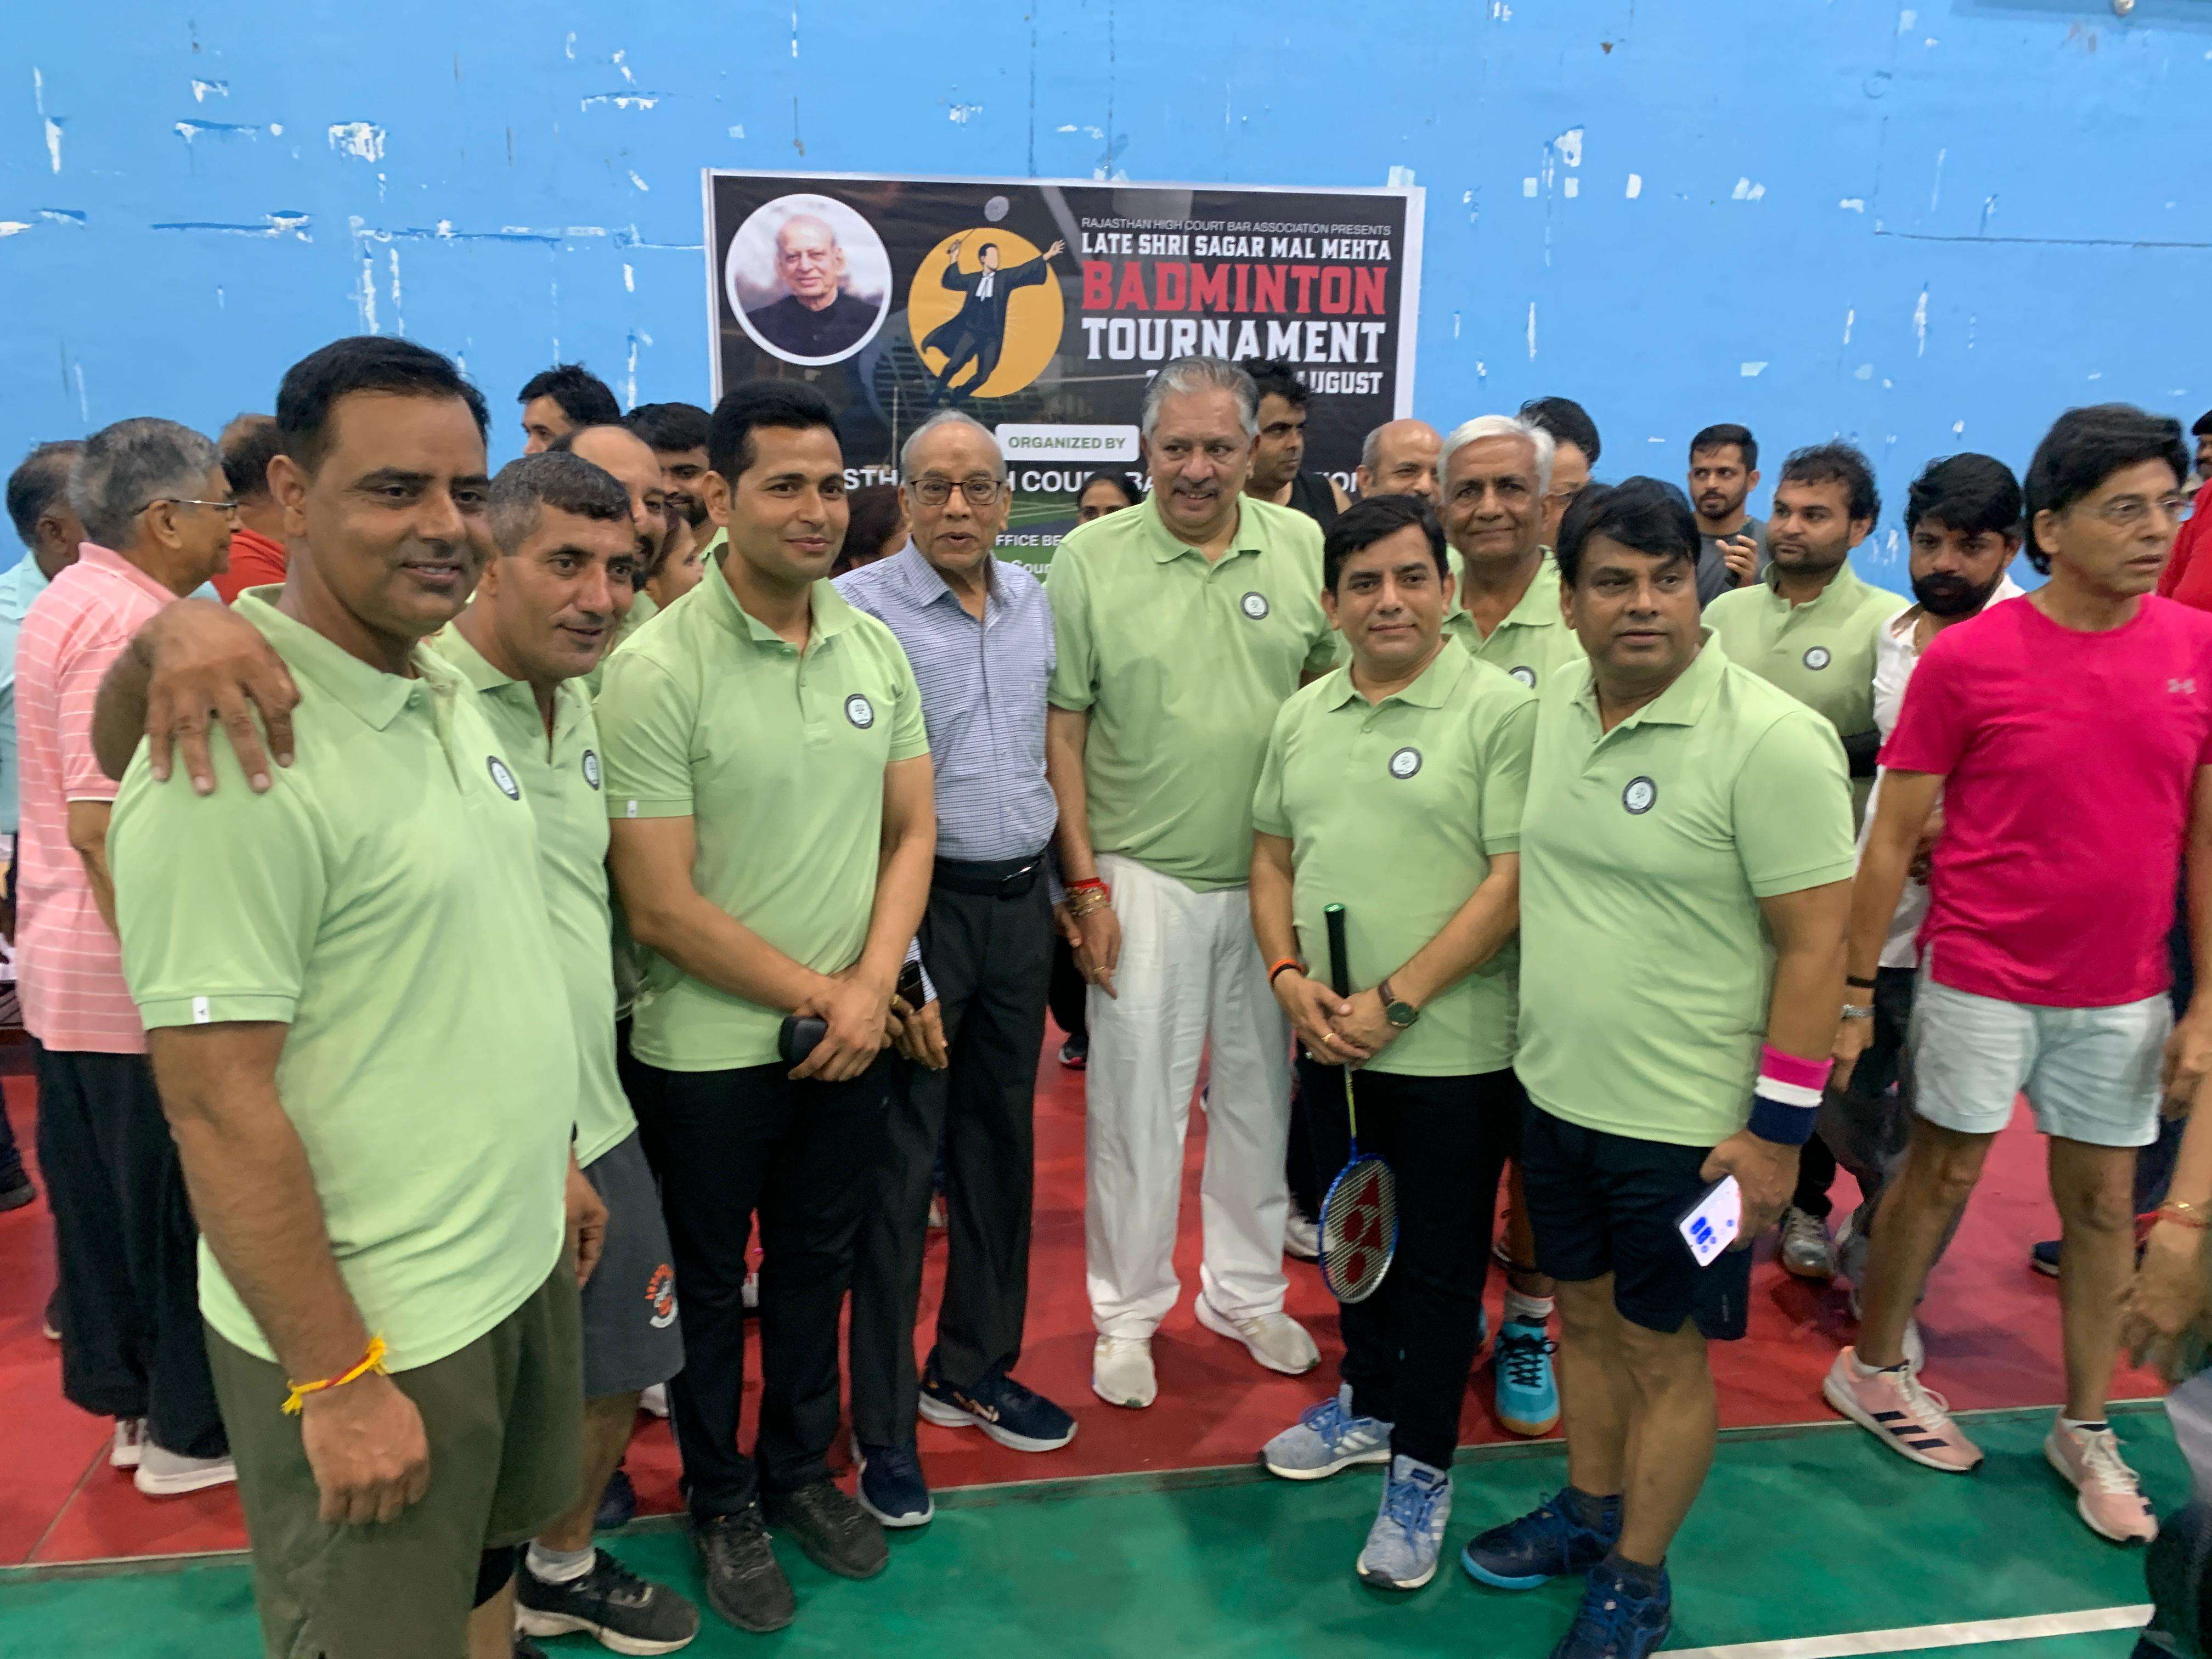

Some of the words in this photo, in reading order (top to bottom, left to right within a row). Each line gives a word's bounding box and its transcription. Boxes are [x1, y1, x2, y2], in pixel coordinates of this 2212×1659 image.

[1081, 218, 1151, 229] RAJASTHAN
[1153, 219, 1182, 230] HIGH
[1184, 220, 1226, 231] COURT
[1227, 221, 1251, 232] BAR
[1252, 222, 1329, 234] ASSOCIATION
[1330, 224, 1392, 236] PRESENTS
[1081, 233, 1133, 254] LATE
[1138, 234, 1190, 255] SHRI
[1194, 235, 1265, 257] SAGAR
[1270, 236, 1316, 258] MAL
[1321, 238, 1392, 260] MEHTA
[1081, 261, 1388, 314] BADMINTON
[1081, 317, 1386, 363] TOURNAMENT
[1008, 436, 1102, 449] ORGANIZED
[1105, 437, 1126, 449] BY
[1021, 471, 1096, 492] COU
[995, 534, 1040, 546] FFICE
